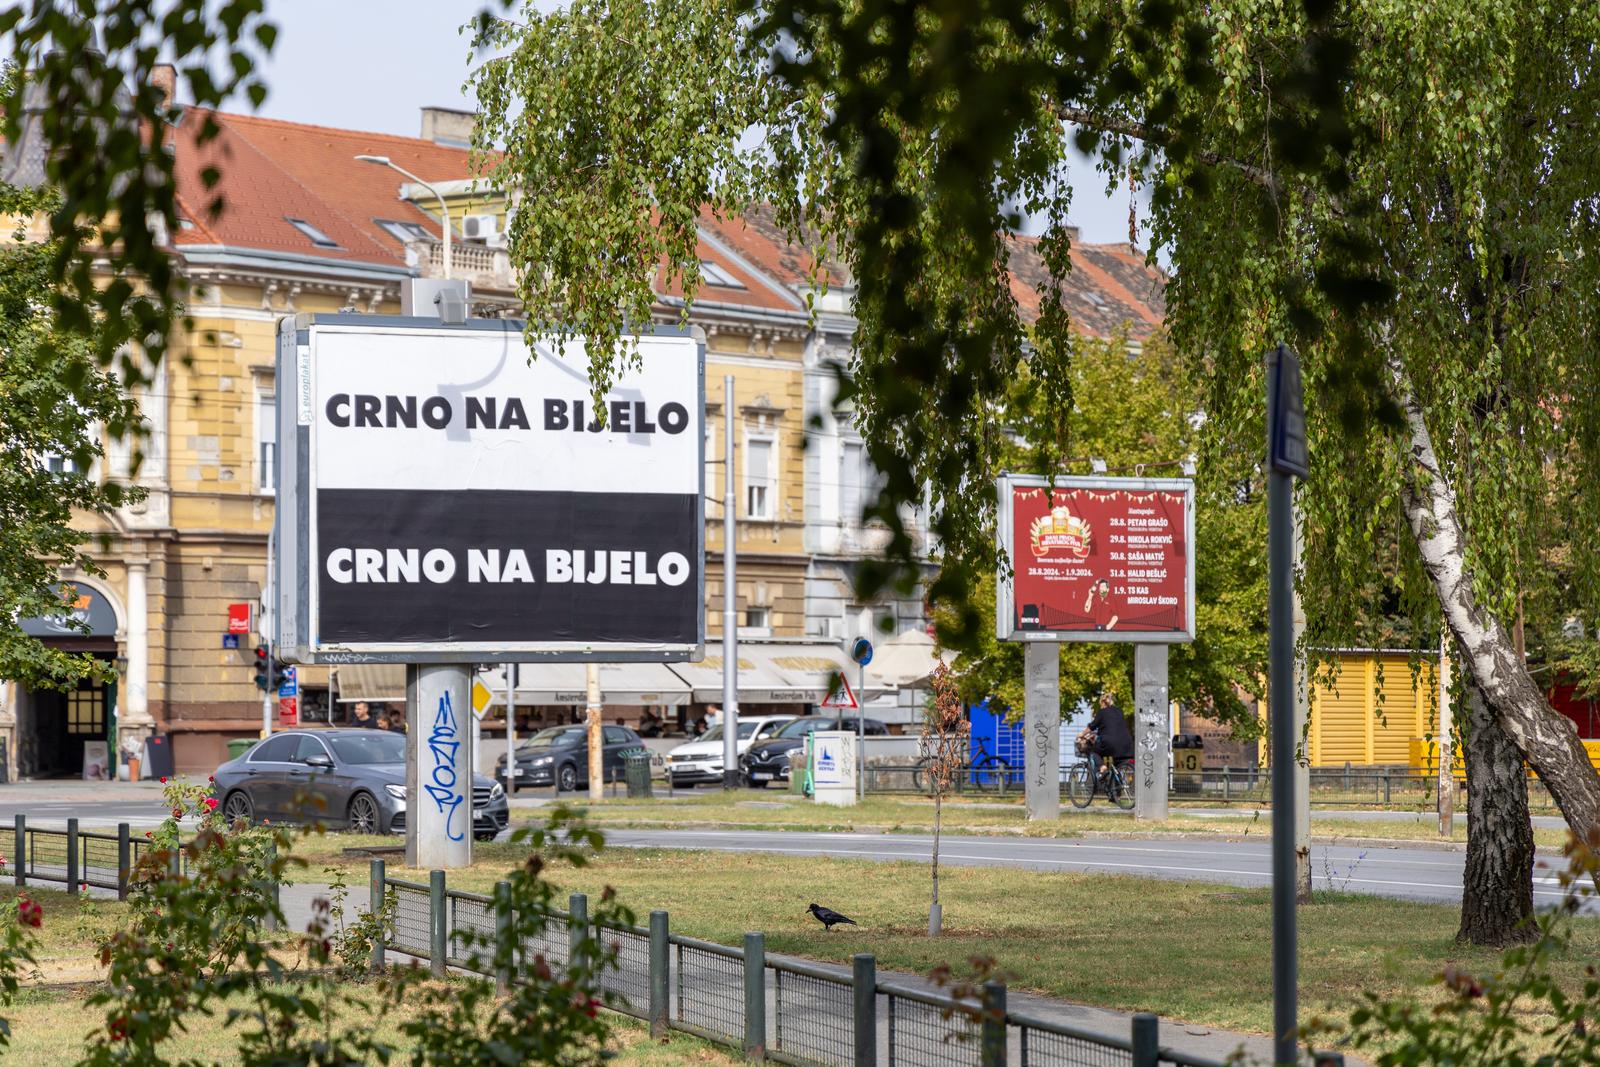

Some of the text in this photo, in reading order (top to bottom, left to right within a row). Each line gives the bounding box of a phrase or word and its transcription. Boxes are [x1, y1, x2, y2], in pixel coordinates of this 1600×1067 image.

[325, 393, 453, 430] CRNO
[465, 397, 531, 430] NA
[1110, 516, 1168, 527] 28.8. PETAR GRAŠO
[1110, 534, 1173, 544] 29.8. NIKOLA ROKVIĆ
[1110, 551, 1165, 560] 30.8. SAŠA MATIĆ
[326, 547, 690, 586] CRNO NA BIJELO
[1110, 568, 1167, 578] 31.8. HALID BEŠLIĆ
[1114, 586, 1126, 595] 1.9.
[1127, 595, 1178, 605] MIROSLAV ŠKORO
[770, 690, 803, 700] Amsterdam
[652, 753, 664, 766] ub
